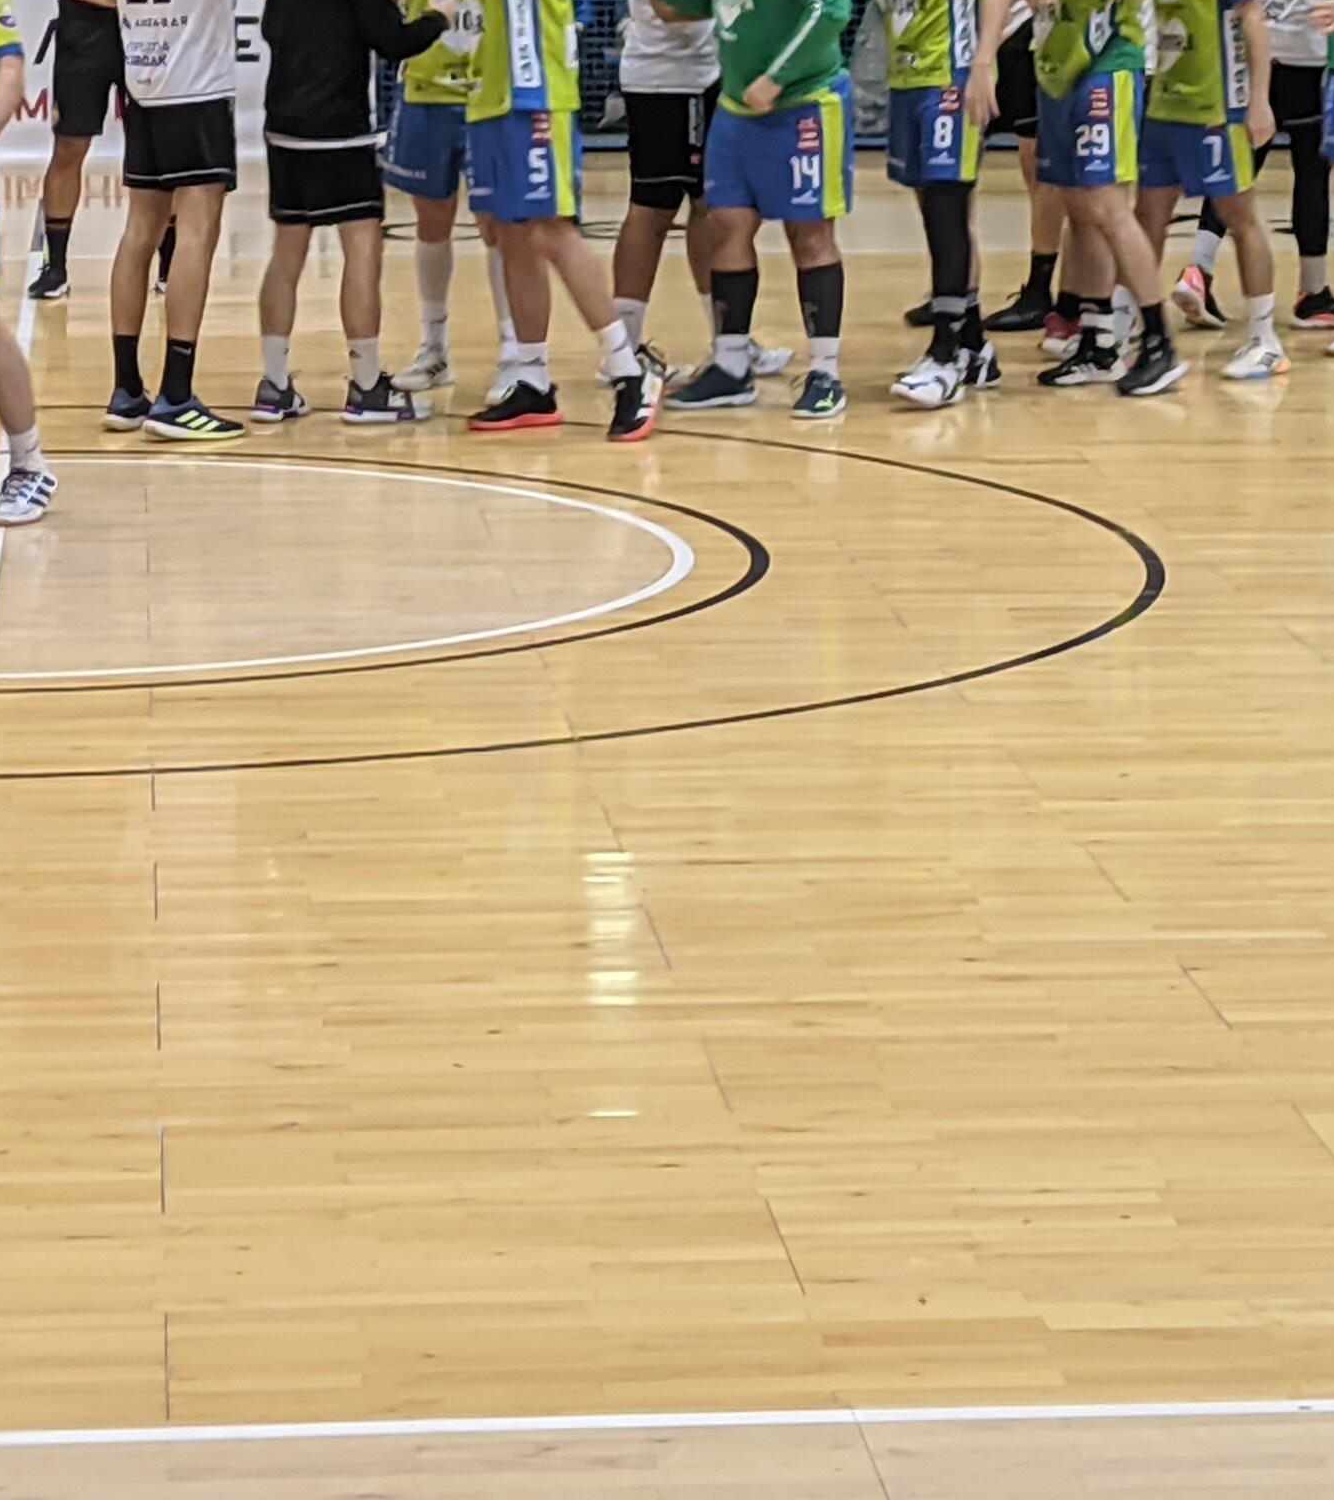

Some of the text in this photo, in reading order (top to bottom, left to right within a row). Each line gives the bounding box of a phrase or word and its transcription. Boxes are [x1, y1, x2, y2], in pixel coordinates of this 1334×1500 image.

[933, 116, 953, 148] 8
[1075, 124, 1110, 157] 29
[528, 148, 548, 184] 5
[1203, 136, 1222, 167] 7
[790, 154, 820, 190] 14
